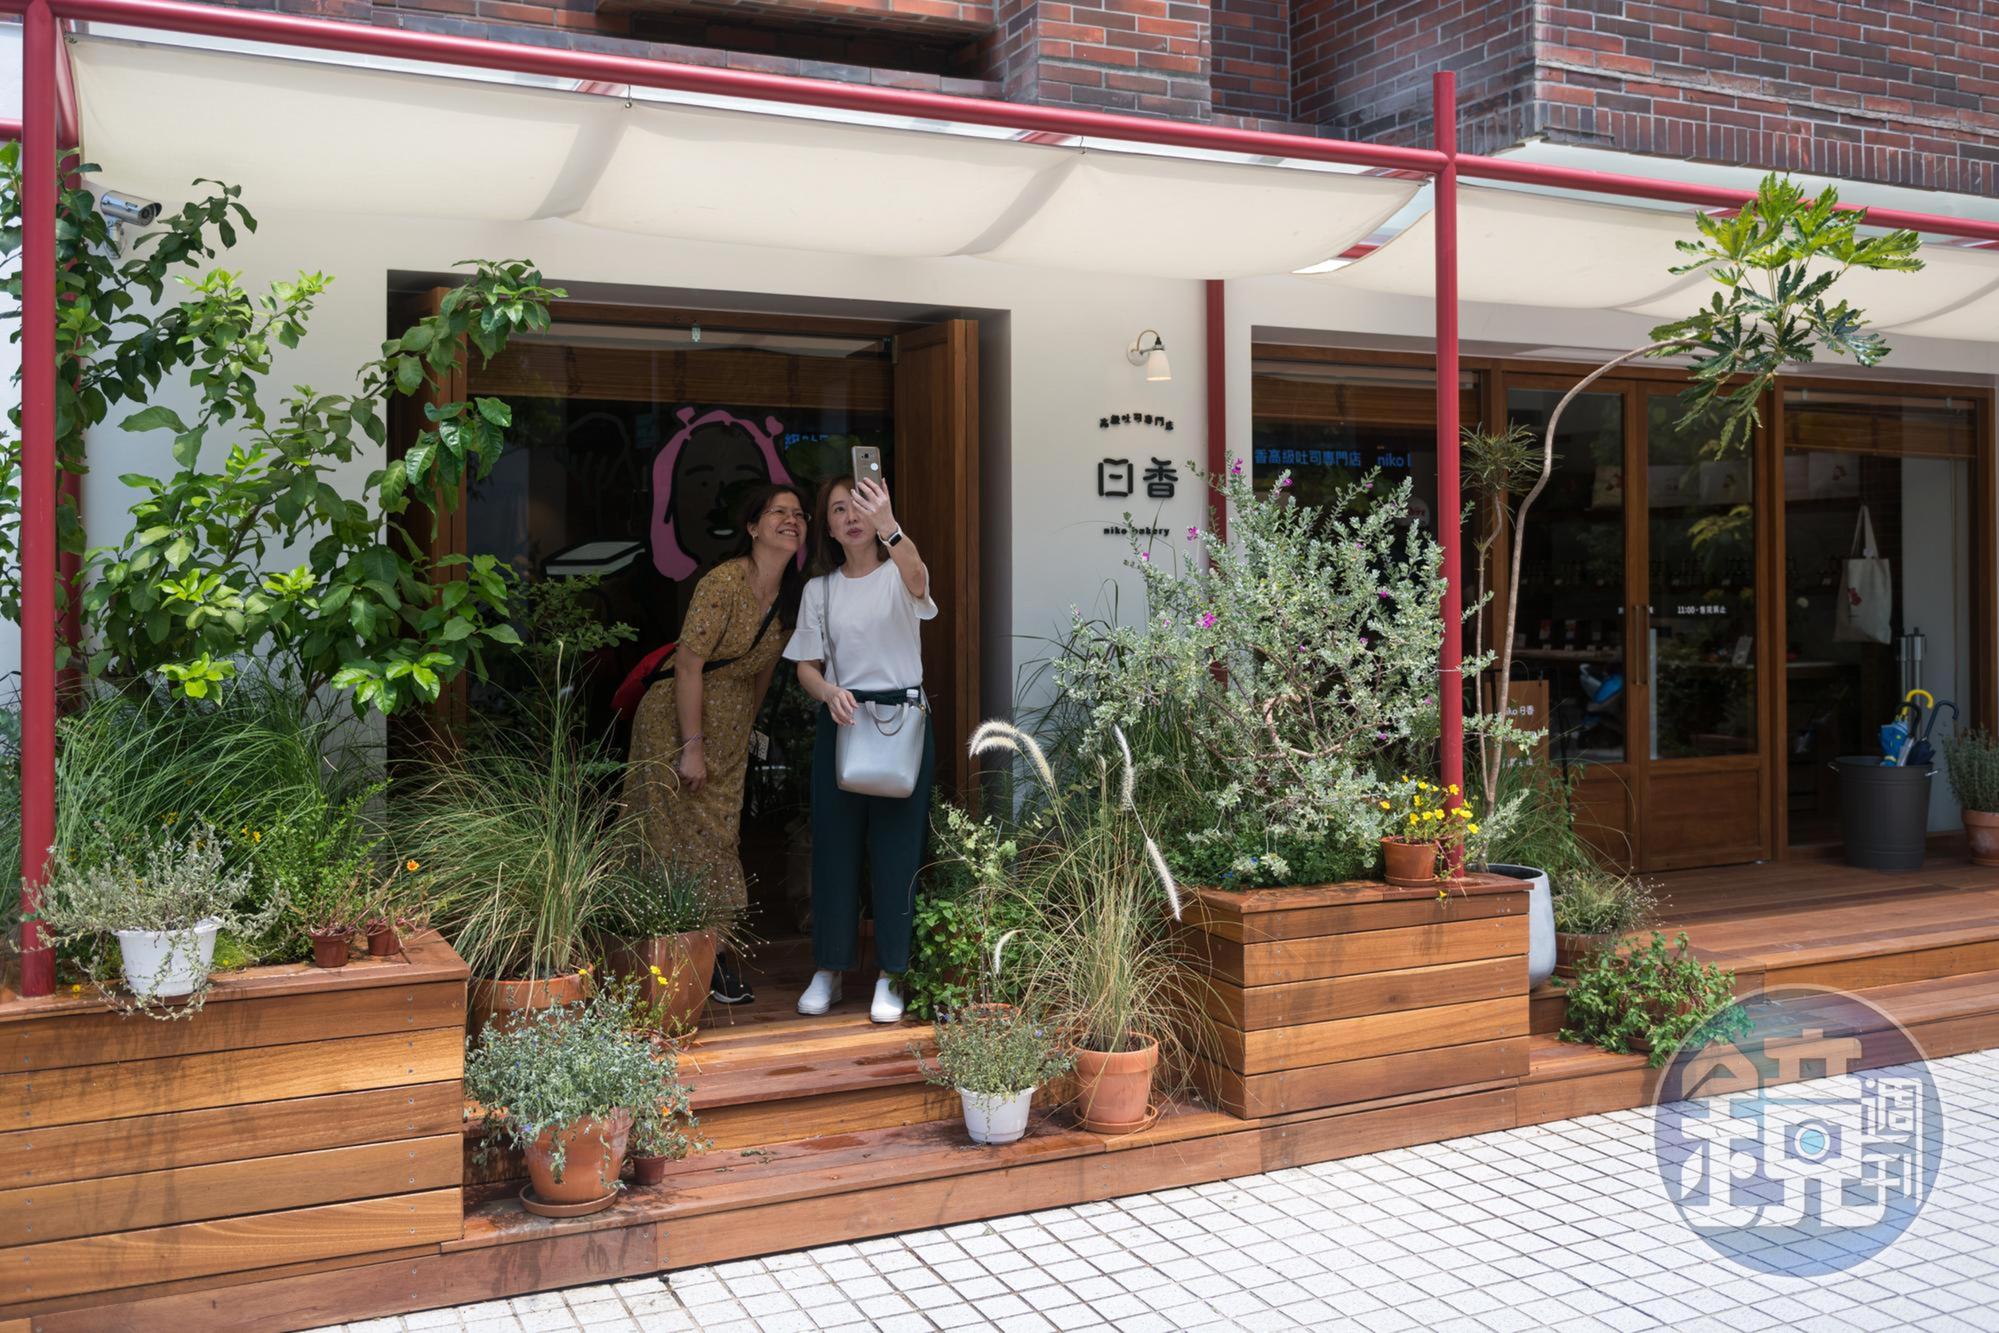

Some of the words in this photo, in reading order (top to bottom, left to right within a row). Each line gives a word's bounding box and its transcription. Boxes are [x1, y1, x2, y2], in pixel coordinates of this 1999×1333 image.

[1376, 453, 1405, 467] niko
[1098, 456, 1179, 498] 日香
[1103, 526, 1127, 535] niko
